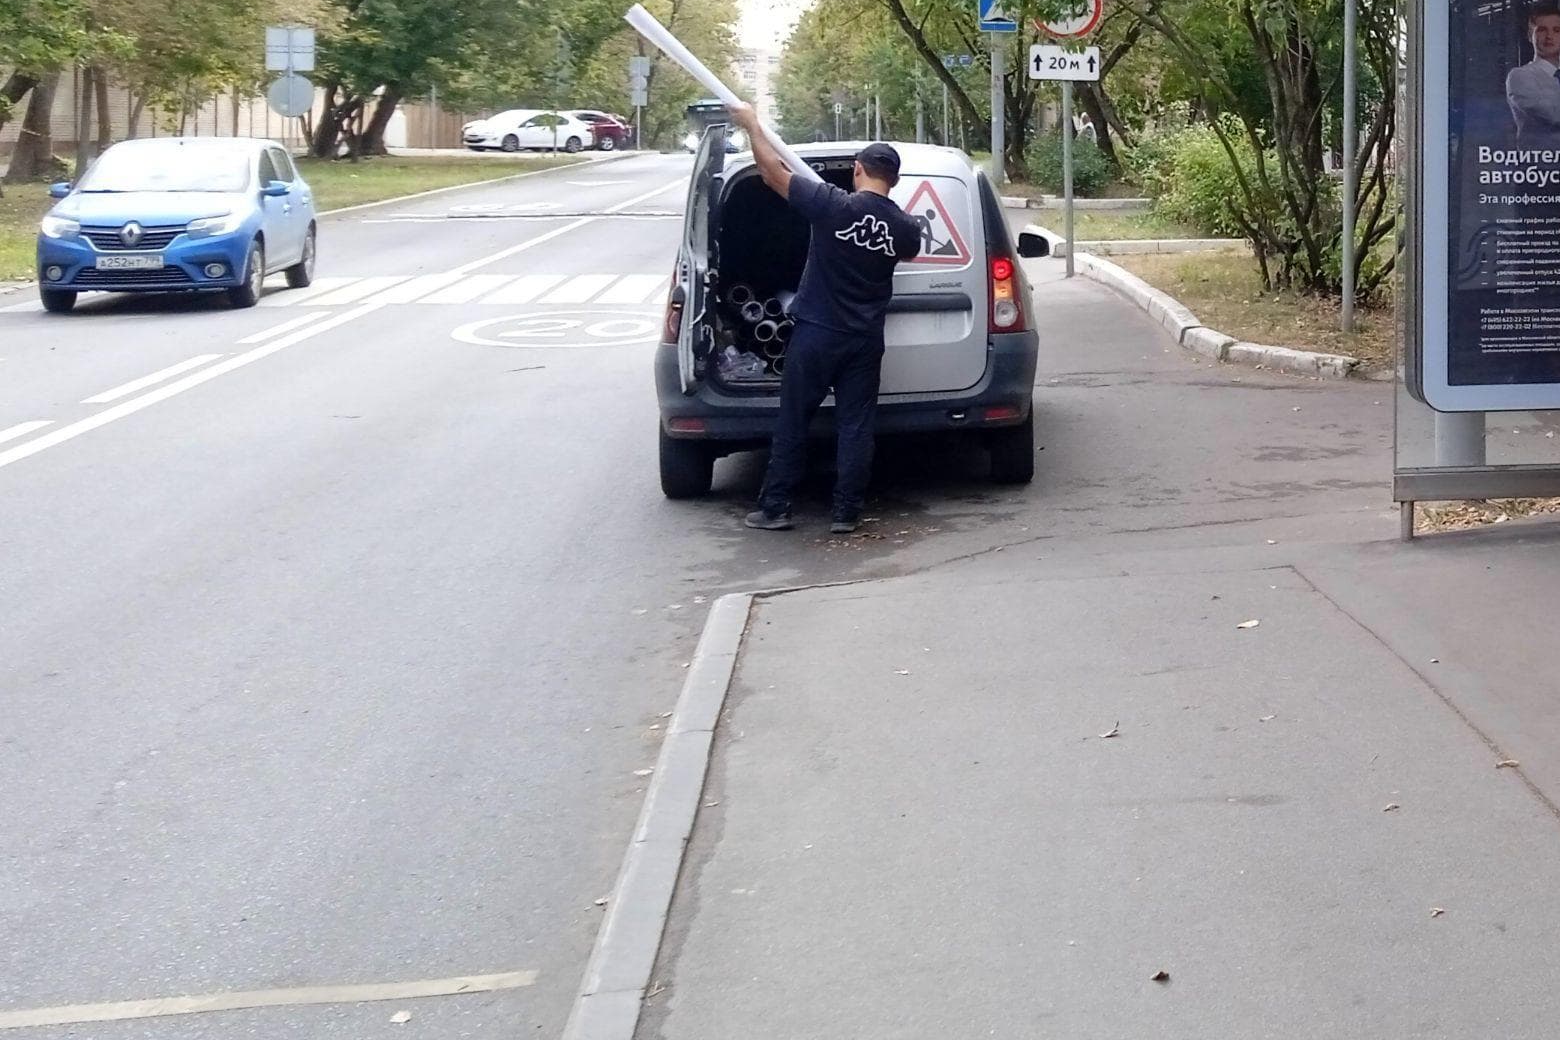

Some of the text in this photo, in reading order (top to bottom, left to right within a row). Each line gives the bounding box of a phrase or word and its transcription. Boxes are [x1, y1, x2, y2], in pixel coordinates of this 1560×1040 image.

[1049, 57, 1067, 70] 20
[1479, 194, 1498, 205] Эта
[1501, 193, 1560, 206] профессия
[498, 319, 656, 338] 20
